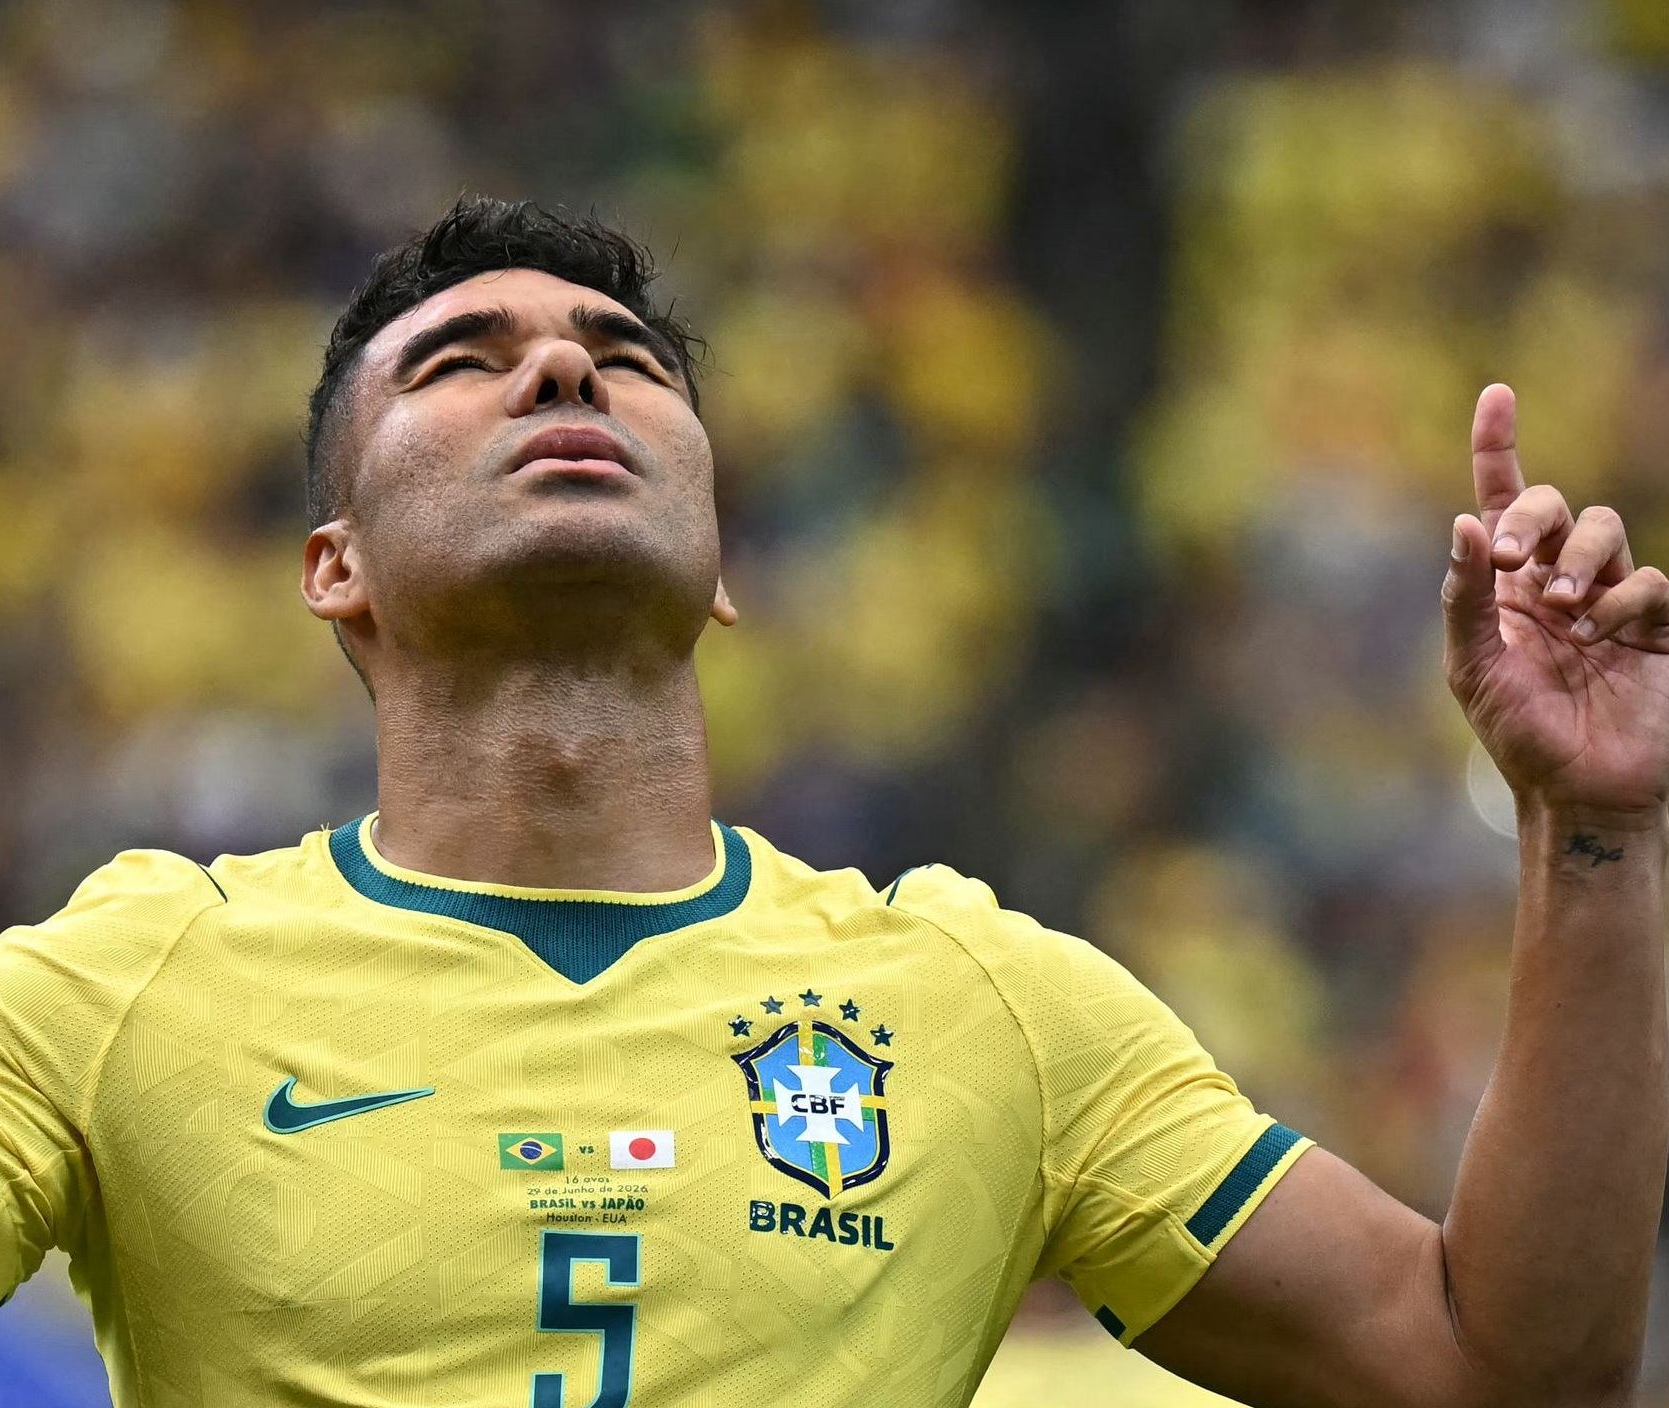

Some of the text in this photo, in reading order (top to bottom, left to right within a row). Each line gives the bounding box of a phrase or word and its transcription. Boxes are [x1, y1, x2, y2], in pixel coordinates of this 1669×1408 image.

[790, 1092, 846, 1116] CBF
[578, 1144, 594, 1154] vs
[565, 1175, 579, 1184] 16
[527, 1187, 541, 1195] 29
[544, 1187, 558, 1195] de
[599, 1185, 613, 1193] de
[618, 1184, 648, 1194] 2026
[601, 1195, 645, 1211] JAPÃO
[602, 1213, 628, 1224] EUA
[749, 1199, 895, 1252] BRASIL
